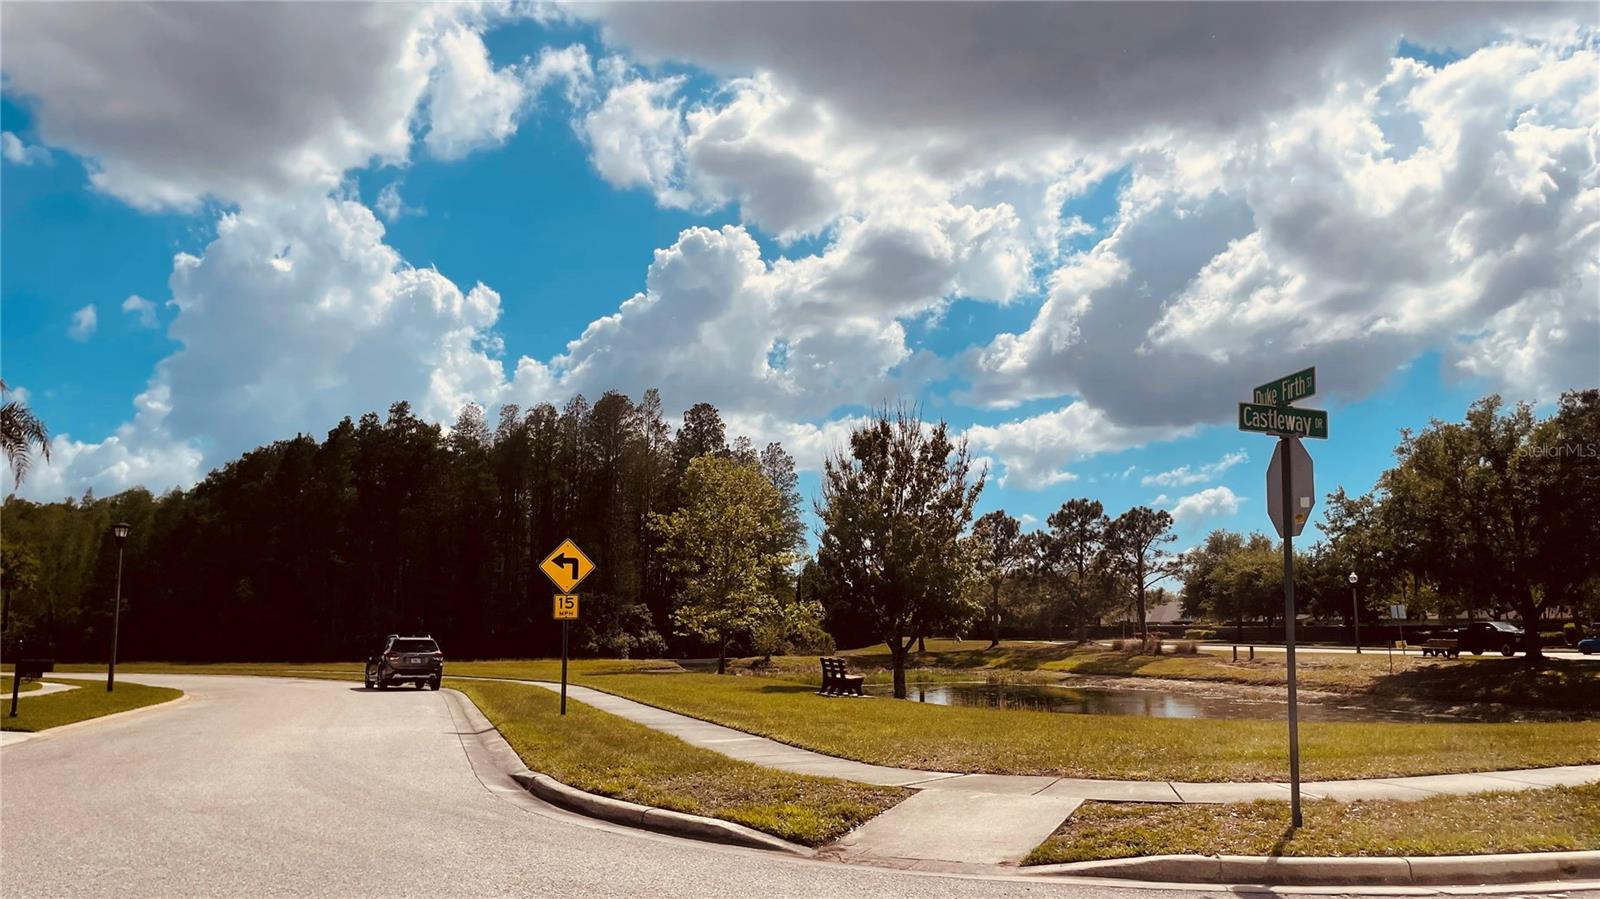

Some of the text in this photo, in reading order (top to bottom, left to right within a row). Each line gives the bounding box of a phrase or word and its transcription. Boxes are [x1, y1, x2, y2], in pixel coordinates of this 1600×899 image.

[1255, 388, 1277, 405] Duke
[1282, 377, 1306, 401] Firth
[1244, 407, 1323, 435] Castleway DR
[558, 597, 574, 609] 15
